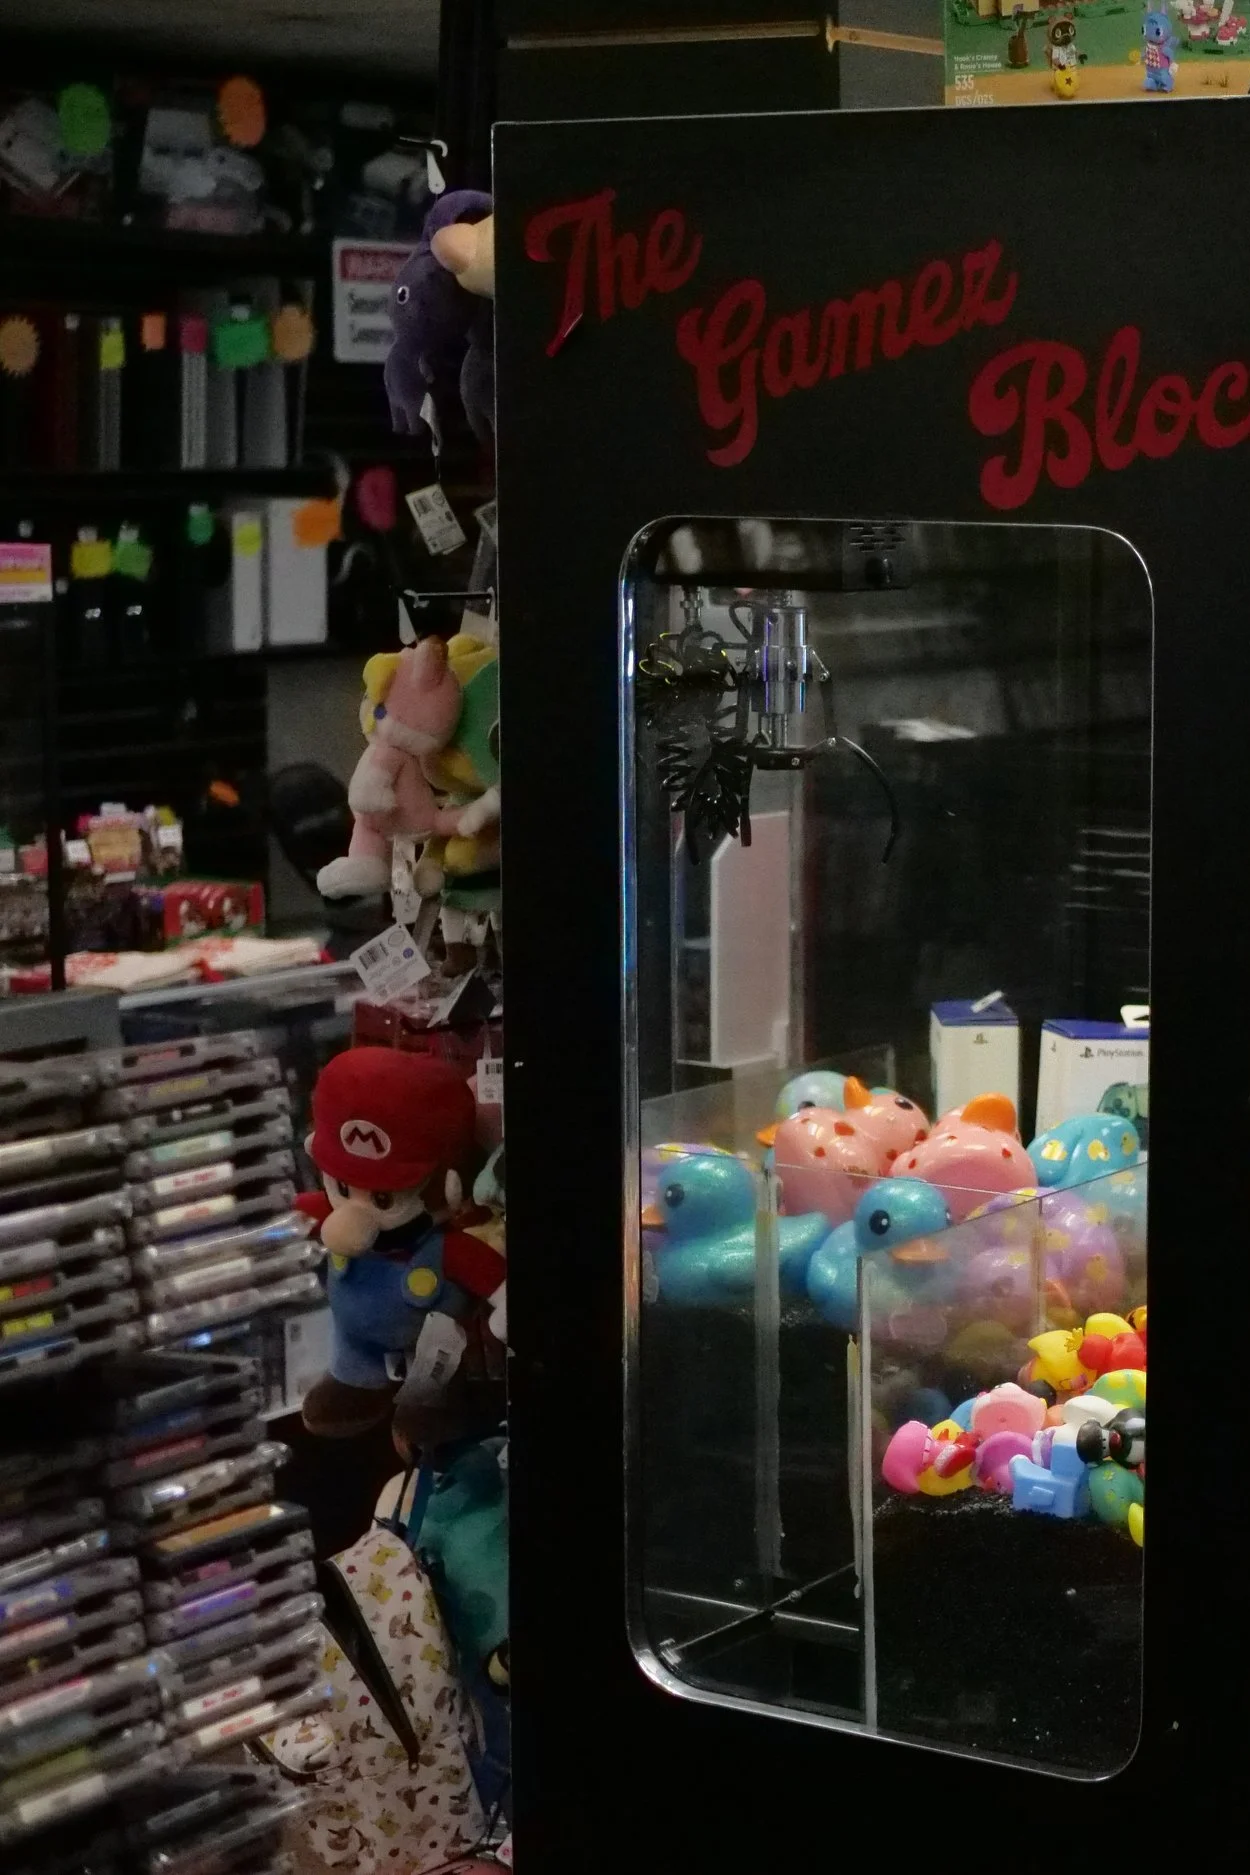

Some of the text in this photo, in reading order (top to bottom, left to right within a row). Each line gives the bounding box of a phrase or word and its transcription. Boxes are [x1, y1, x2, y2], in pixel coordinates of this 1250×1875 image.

[954, 74, 975, 91] 535
[524, 188, 703, 359] The
[676, 240, 1018, 468] Gamez
[1096, 1047, 1144, 1059] PlayStation
[345, 1125, 386, 1153] M
